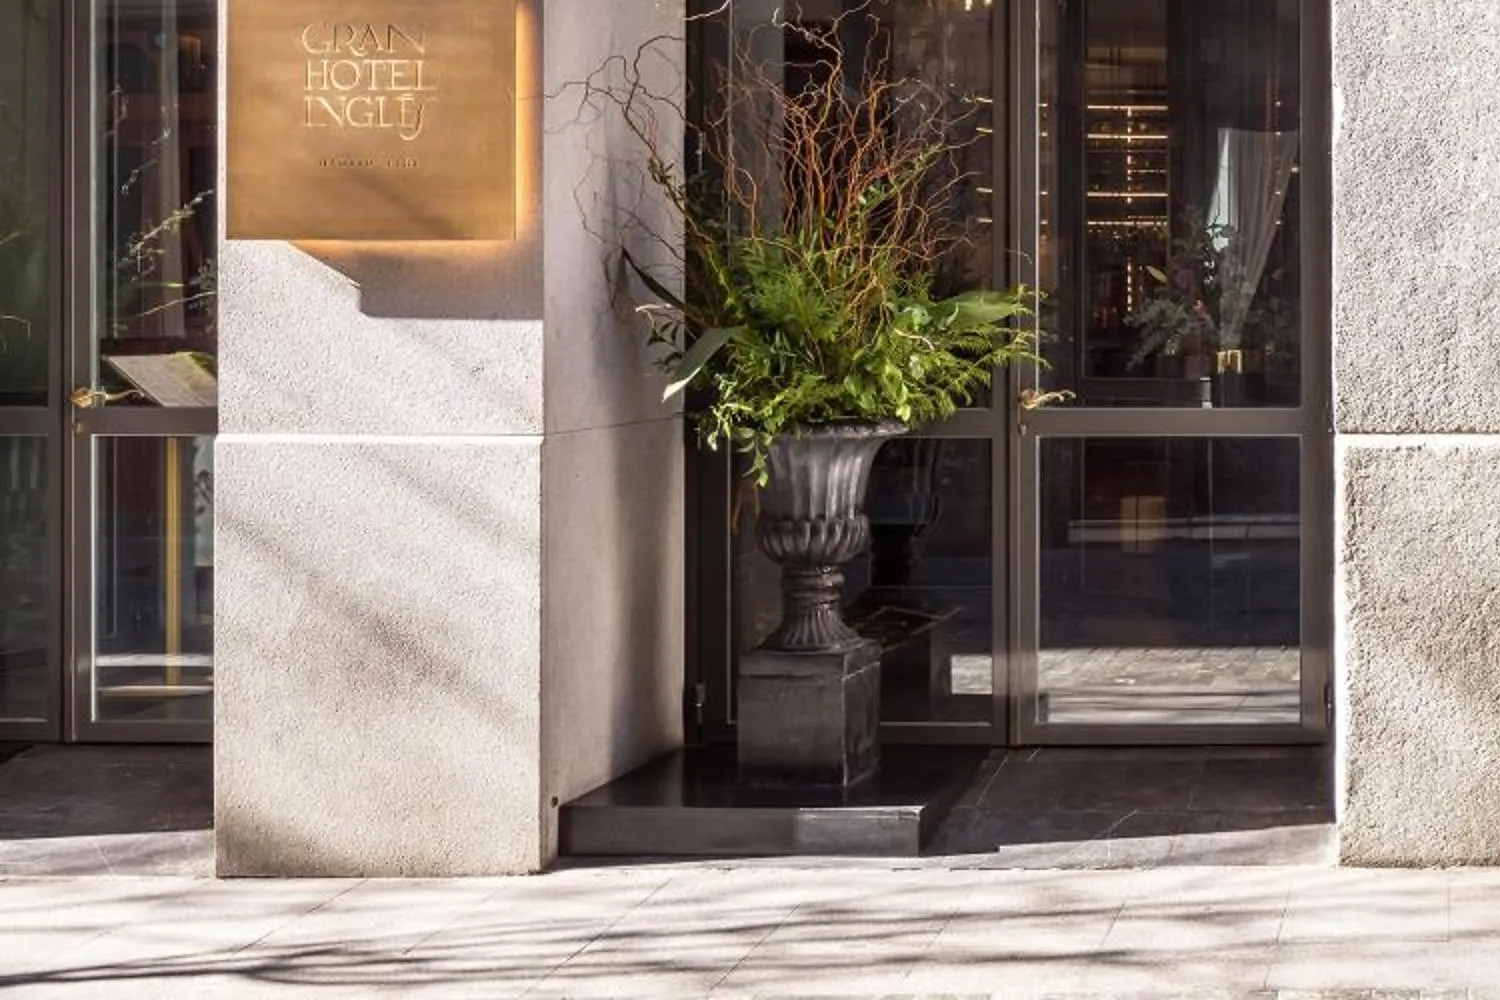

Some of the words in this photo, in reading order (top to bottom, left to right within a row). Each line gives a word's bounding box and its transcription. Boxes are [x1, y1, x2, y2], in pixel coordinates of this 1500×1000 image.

[301, 23, 426, 57] GRAN
[303, 59, 439, 91] HOTEL
[303, 93, 439, 141] INGLÉS
